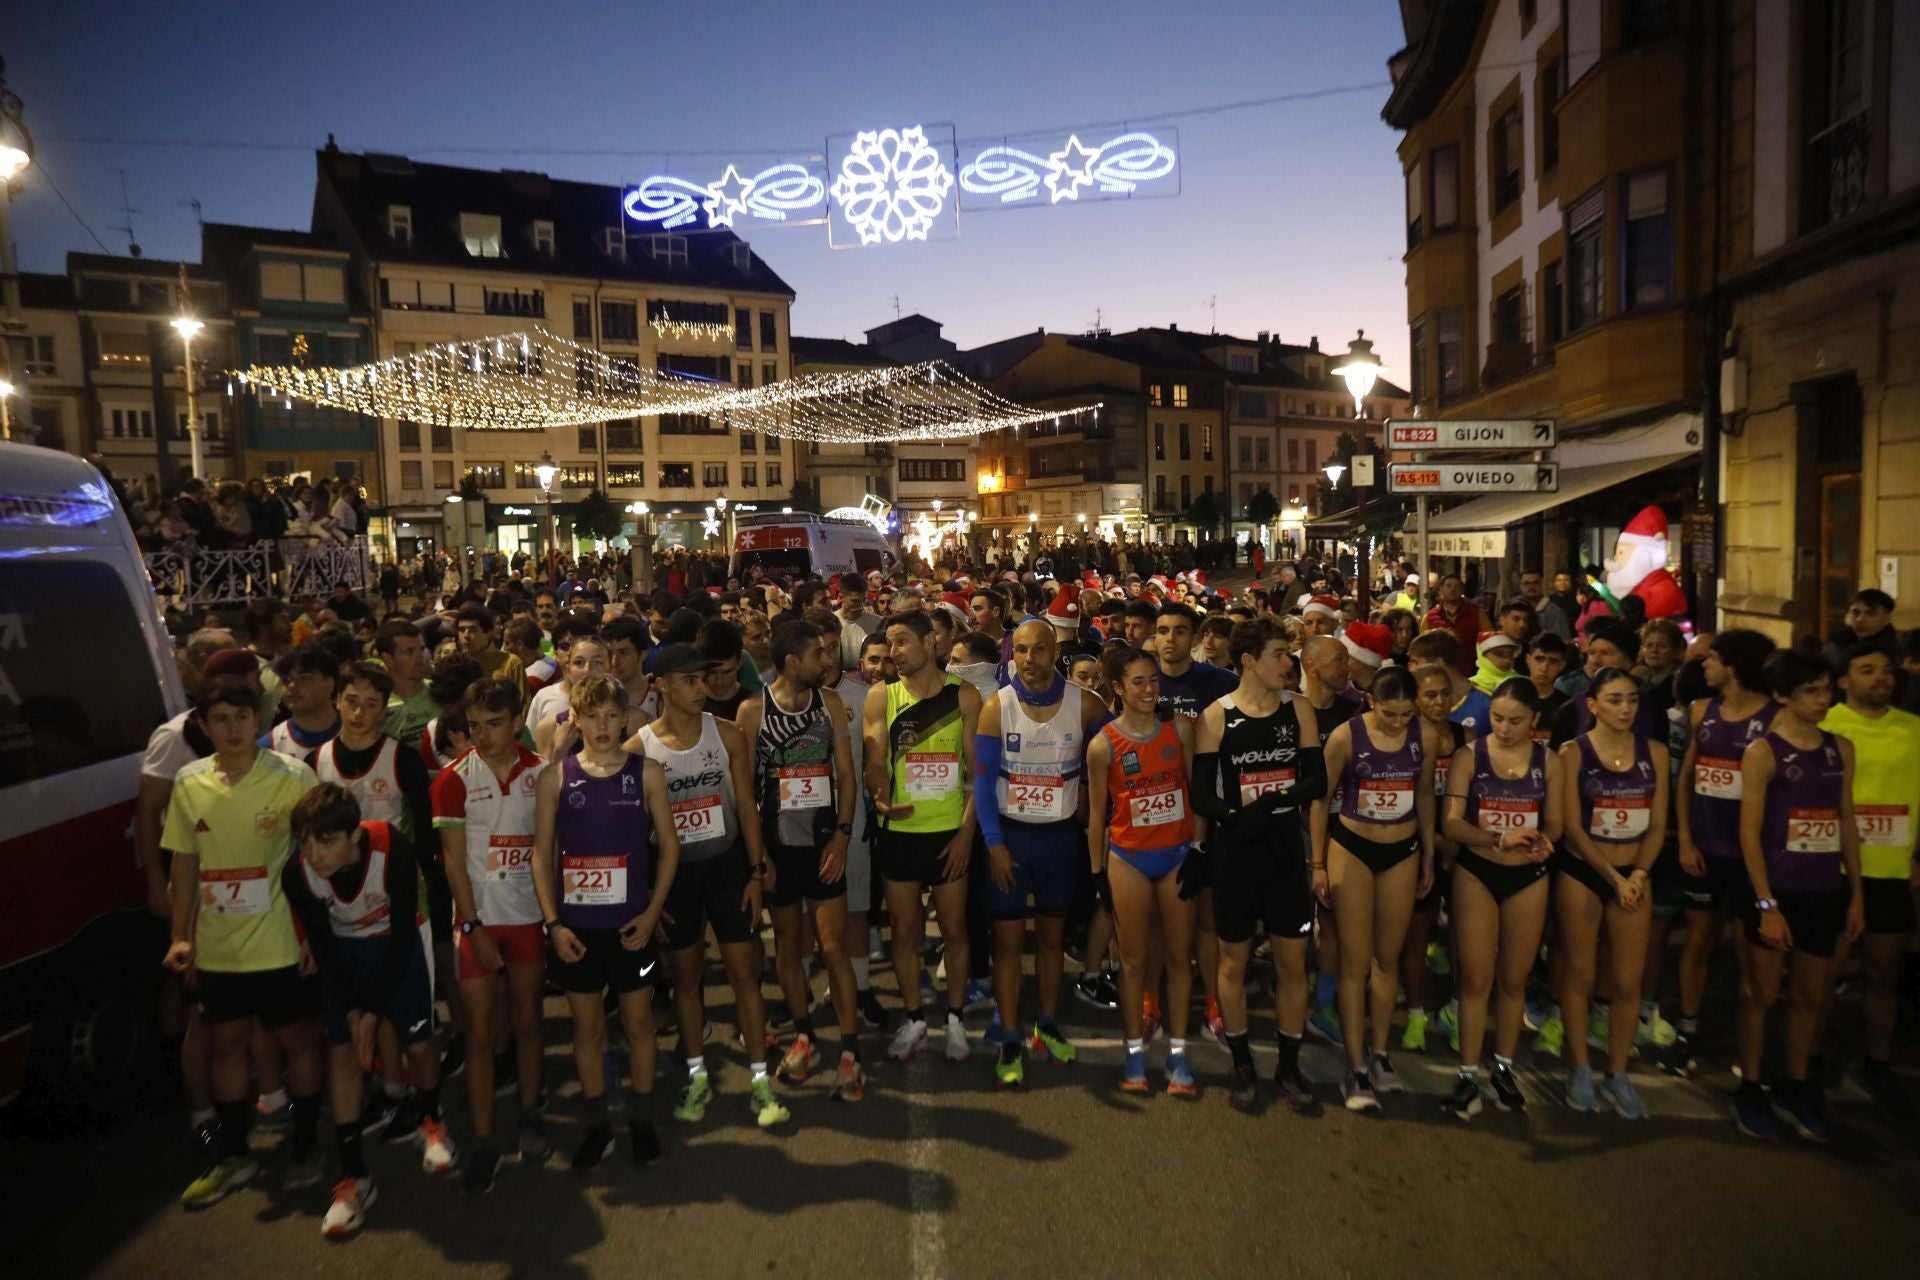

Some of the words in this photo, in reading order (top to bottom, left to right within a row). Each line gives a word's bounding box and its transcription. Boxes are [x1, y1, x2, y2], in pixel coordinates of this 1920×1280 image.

[1395, 429, 1435, 441] N-632
[1455, 428, 1504, 441] GIJON
[1399, 472, 1438, 484] AS-113
[1453, 472, 1514, 484] OVIEDO
[783, 537, 802, 547] 112
[1231, 747, 1296, 766] WOLVES
[914, 763, 949, 779] 259
[1699, 767, 1734, 785] 269
[668, 770, 725, 792] OLVES
[801, 779, 813, 794] 3
[1016, 786, 1054, 803] 246
[1374, 791, 1398, 807] 32
[1138, 793, 1176, 814] 248
[675, 810, 711, 830] 201
[1490, 812, 1526, 828] 210
[1616, 810, 1628, 825] 9
[1862, 817, 1893, 832] 311
[1797, 822, 1836, 838] 270
[500, 848, 532, 866] 184
[576, 870, 612, 888] 221
[226, 882, 241, 899] 7
